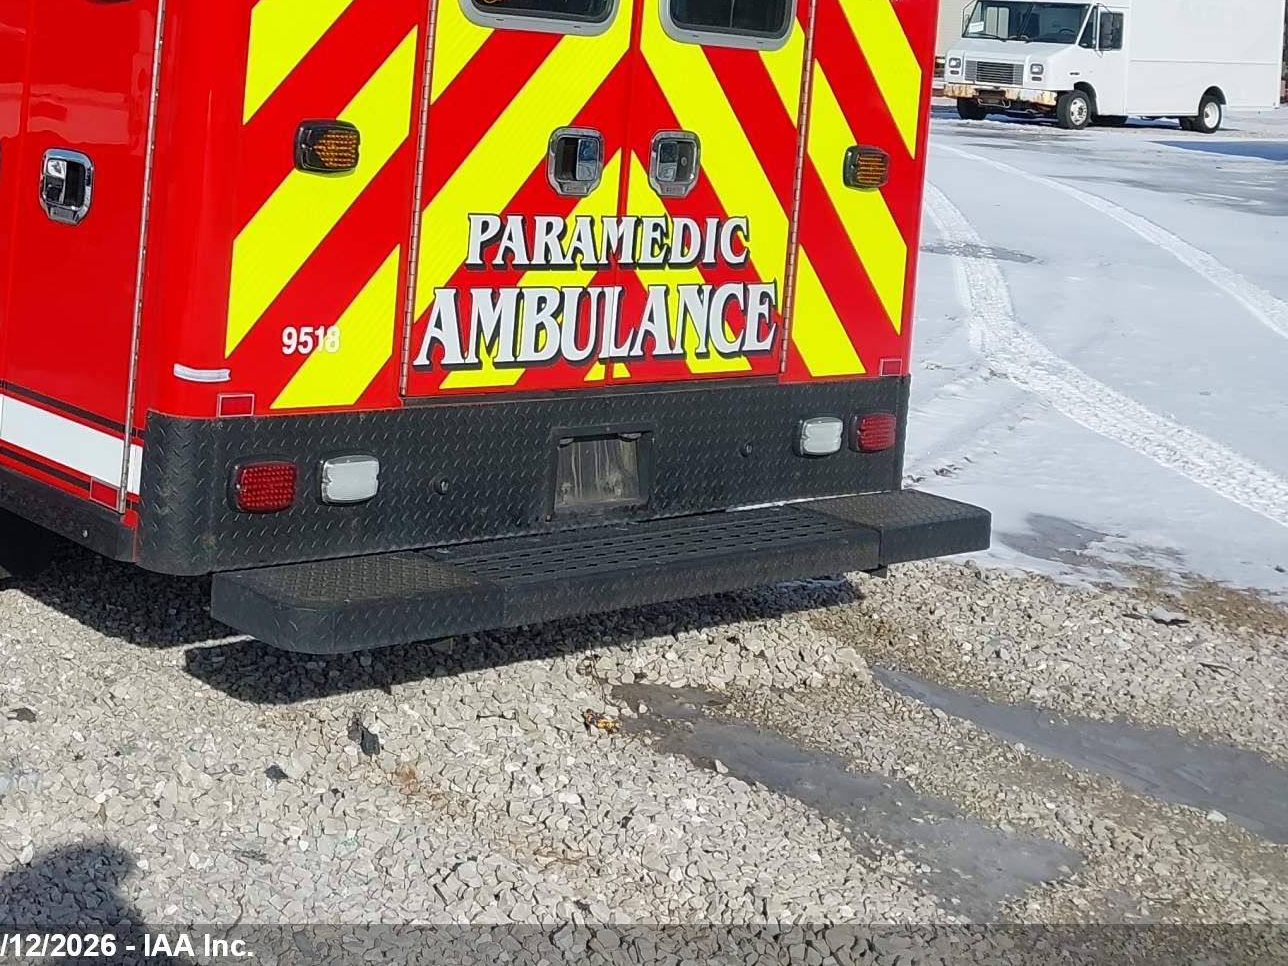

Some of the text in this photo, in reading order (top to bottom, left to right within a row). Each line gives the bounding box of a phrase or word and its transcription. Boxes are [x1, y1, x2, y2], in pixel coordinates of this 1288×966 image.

[464, 213, 749, 270] PARAMEDIC
[281, 325, 341, 355] 9518
[412, 279, 778, 369] AMBULANCE
